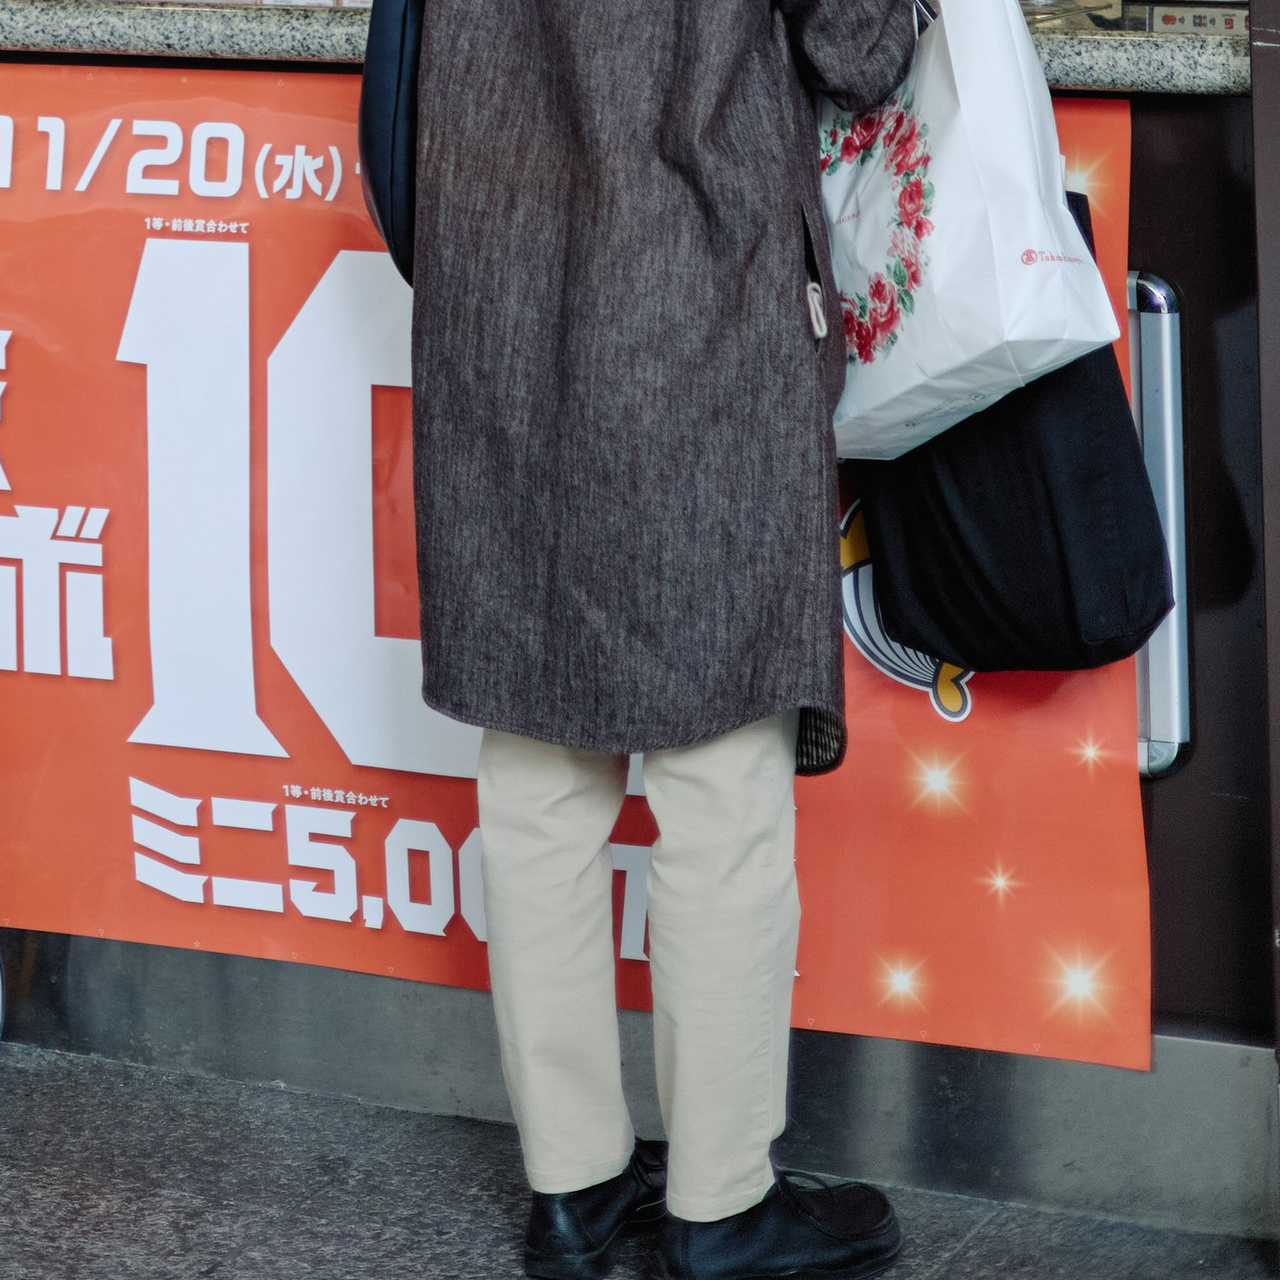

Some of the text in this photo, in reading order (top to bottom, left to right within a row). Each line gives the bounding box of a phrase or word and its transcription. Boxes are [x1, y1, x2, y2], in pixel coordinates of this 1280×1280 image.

[143, 216, 250, 234] 1等・前後賞合わせて
[283, 783, 388, 807] 1等・前後賞合わせて
[128, 776, 488, 939] ミニ5,0
